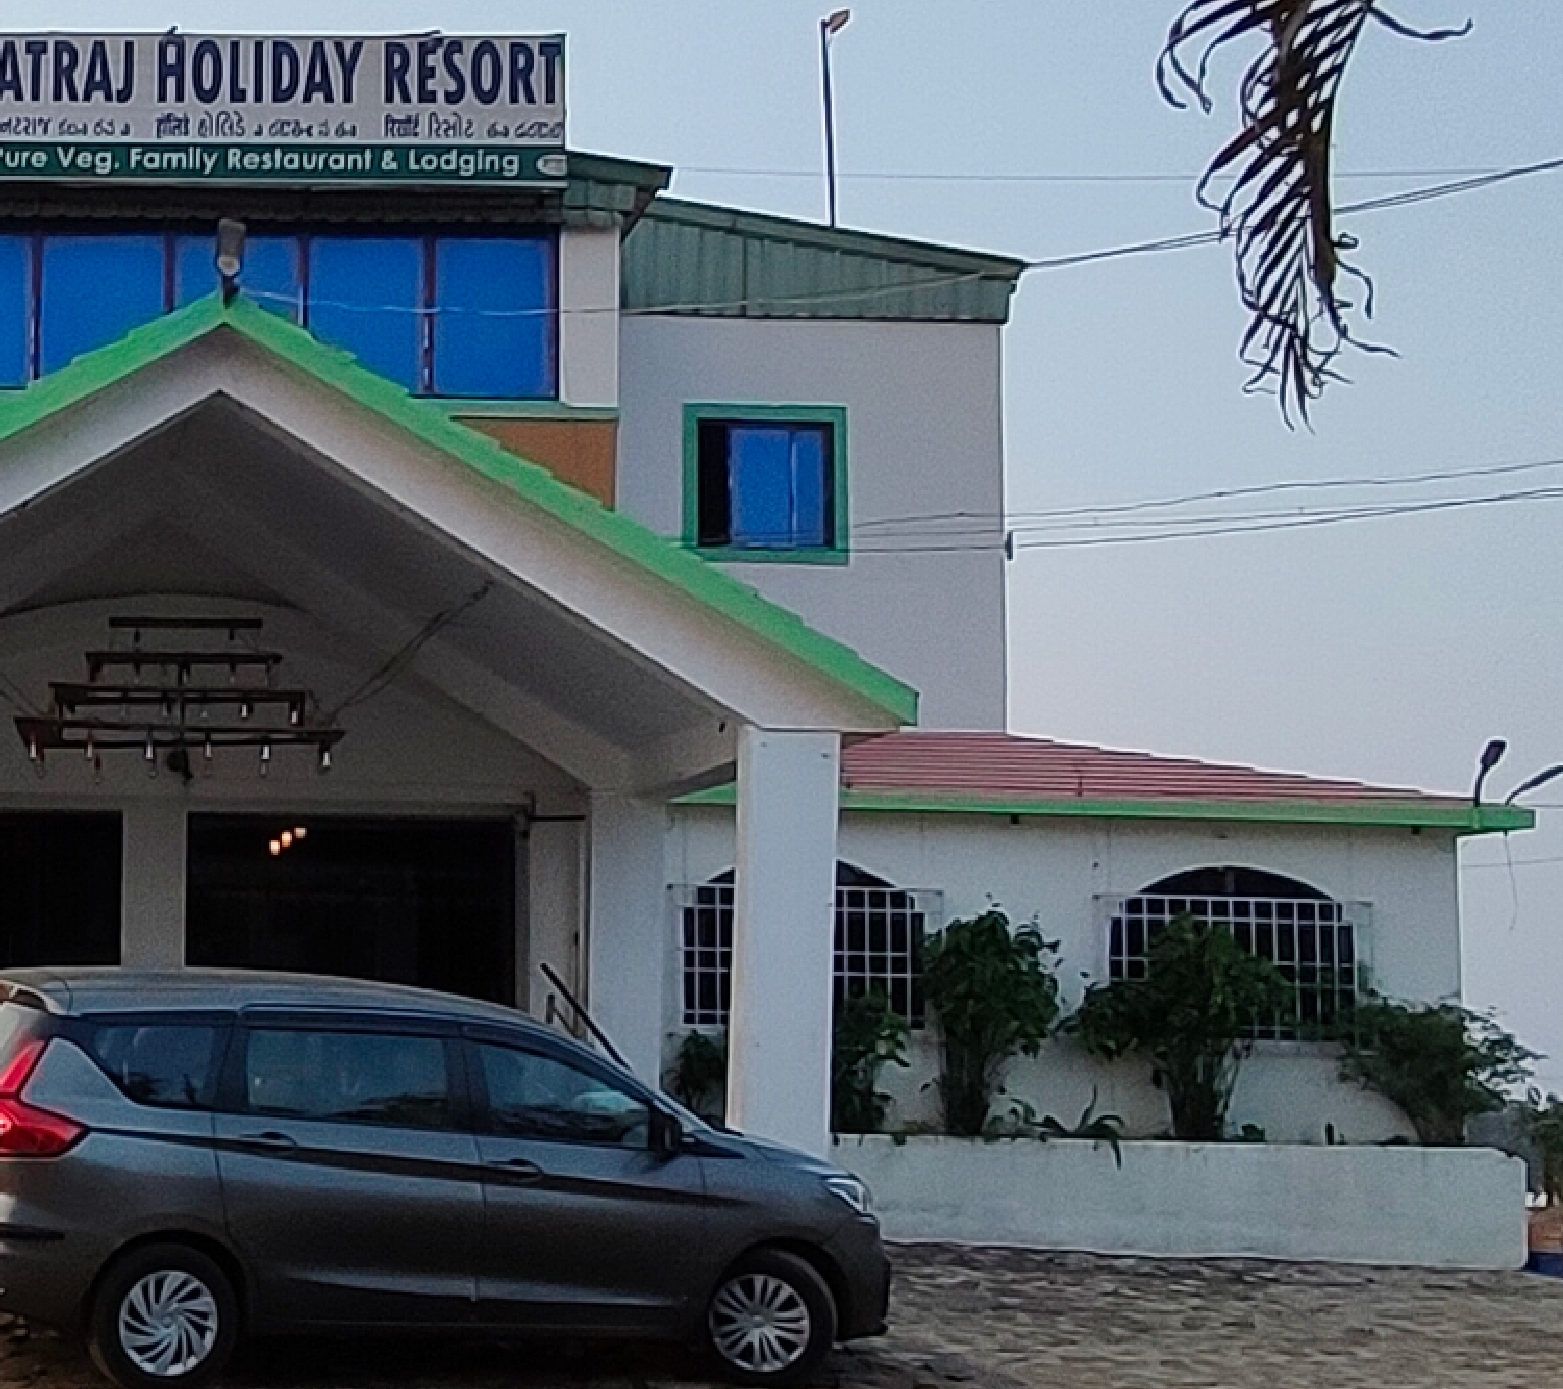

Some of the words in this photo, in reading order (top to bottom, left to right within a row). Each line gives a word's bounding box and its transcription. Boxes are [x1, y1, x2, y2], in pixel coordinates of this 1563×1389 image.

[156, 39, 364, 104] HOLIDAY
[383, 40, 562, 105] RESORT
[56, 146, 120, 175] Veg.
[129, 146, 220, 175] Family
[227, 147, 372, 170] Restaurant
[380, 148, 398, 171] &
[408, 148, 520, 176] Lodging
